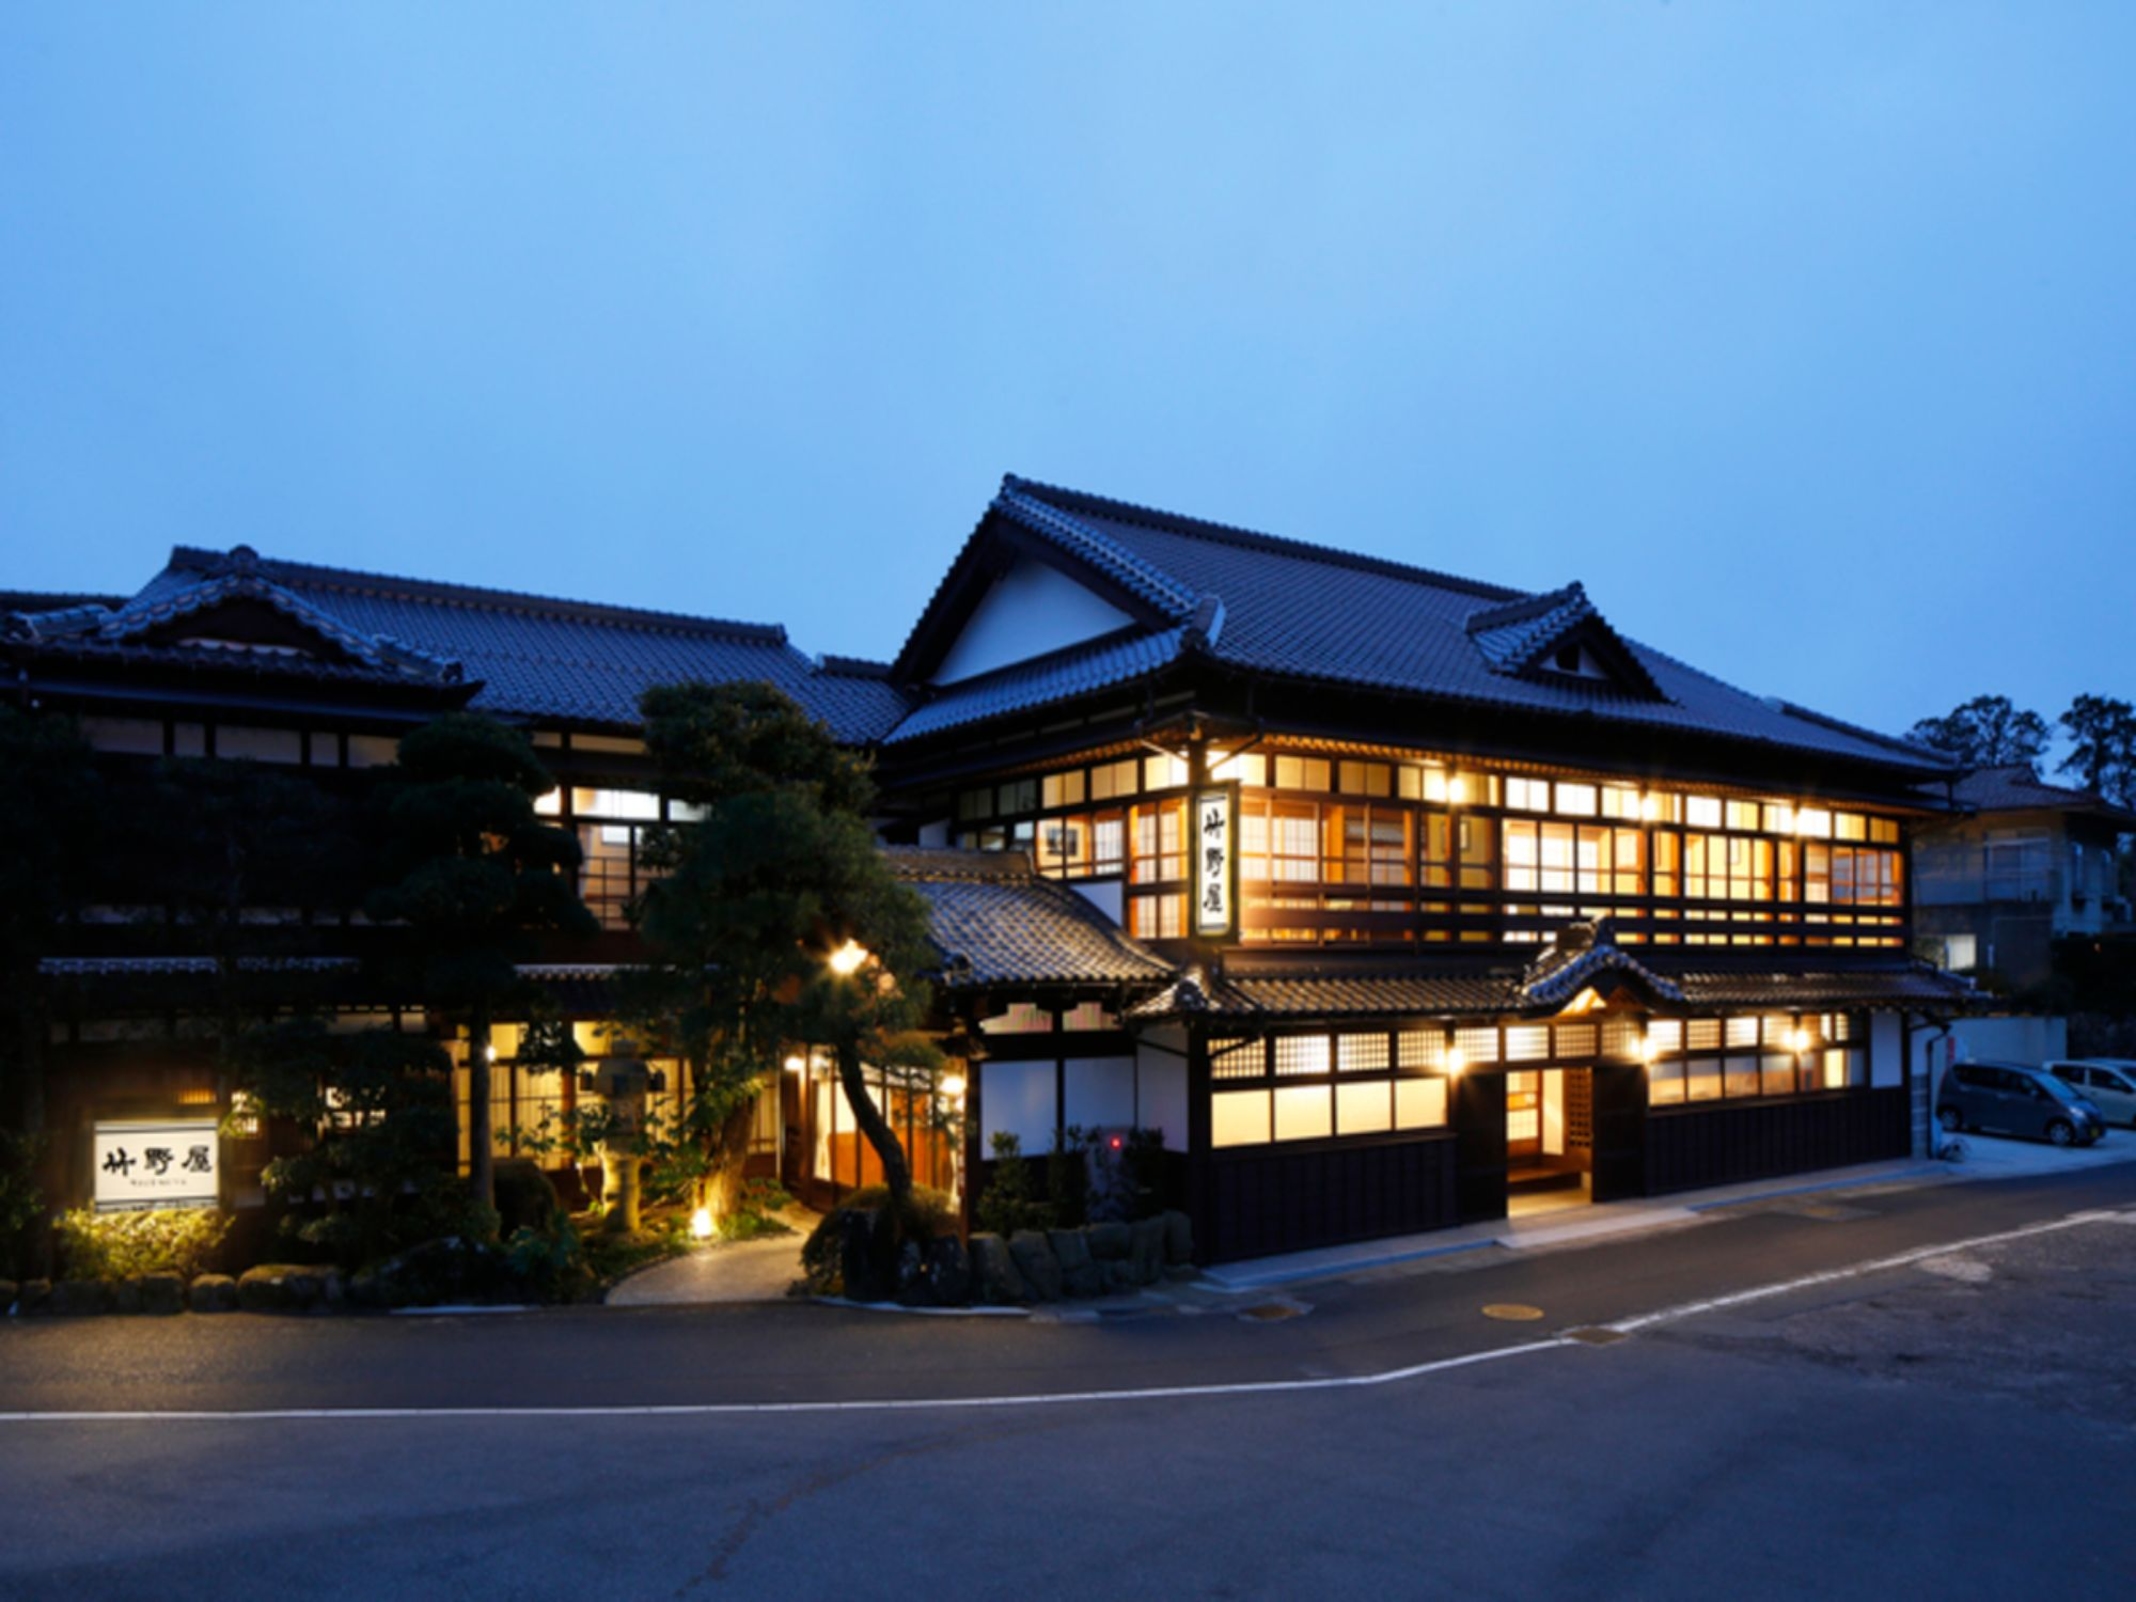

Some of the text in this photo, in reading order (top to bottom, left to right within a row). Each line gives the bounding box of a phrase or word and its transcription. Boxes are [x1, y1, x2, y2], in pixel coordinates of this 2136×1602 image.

[1203, 807, 1225, 912] 竹野屋
[102, 1145, 212, 1177] 竹野屋
